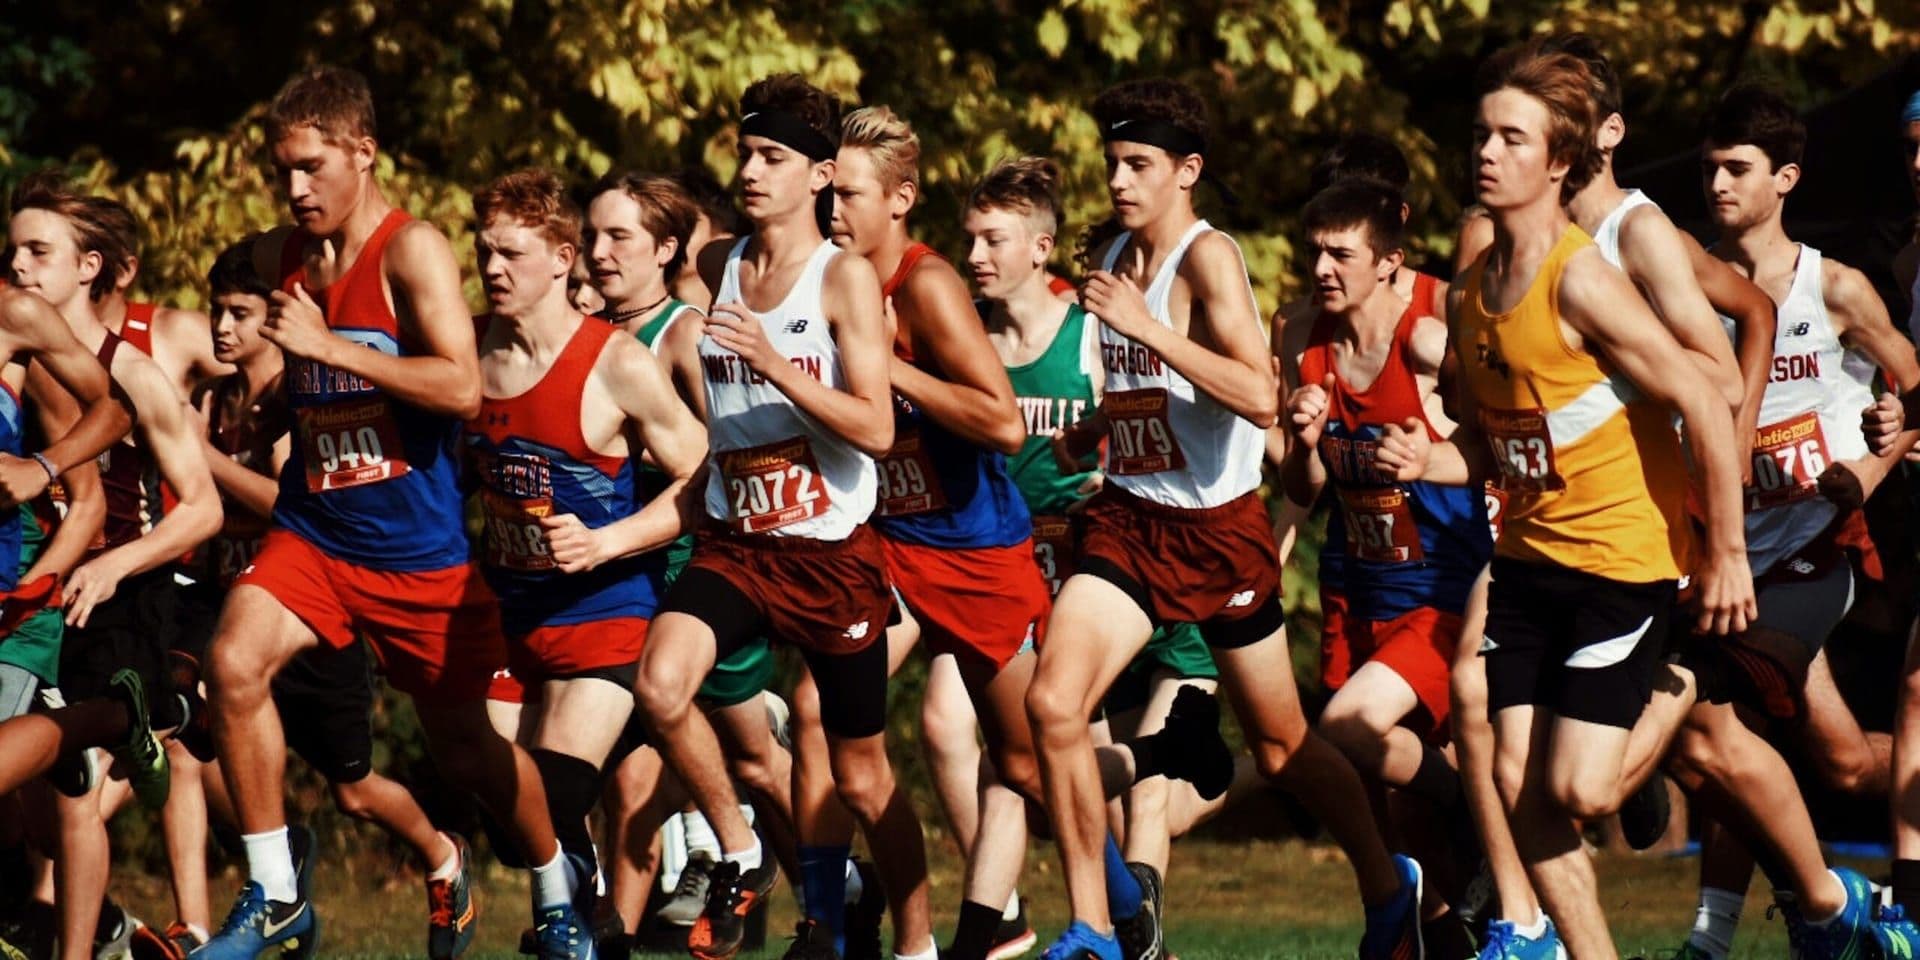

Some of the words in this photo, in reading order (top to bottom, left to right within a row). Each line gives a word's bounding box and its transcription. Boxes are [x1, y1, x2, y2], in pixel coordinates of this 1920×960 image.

[1767, 351, 1820, 383] SON
[317, 427, 385, 472] 940
[1746, 438, 1827, 497] 076
[731, 464, 822, 518] 2072
[876, 457, 927, 499] 939
